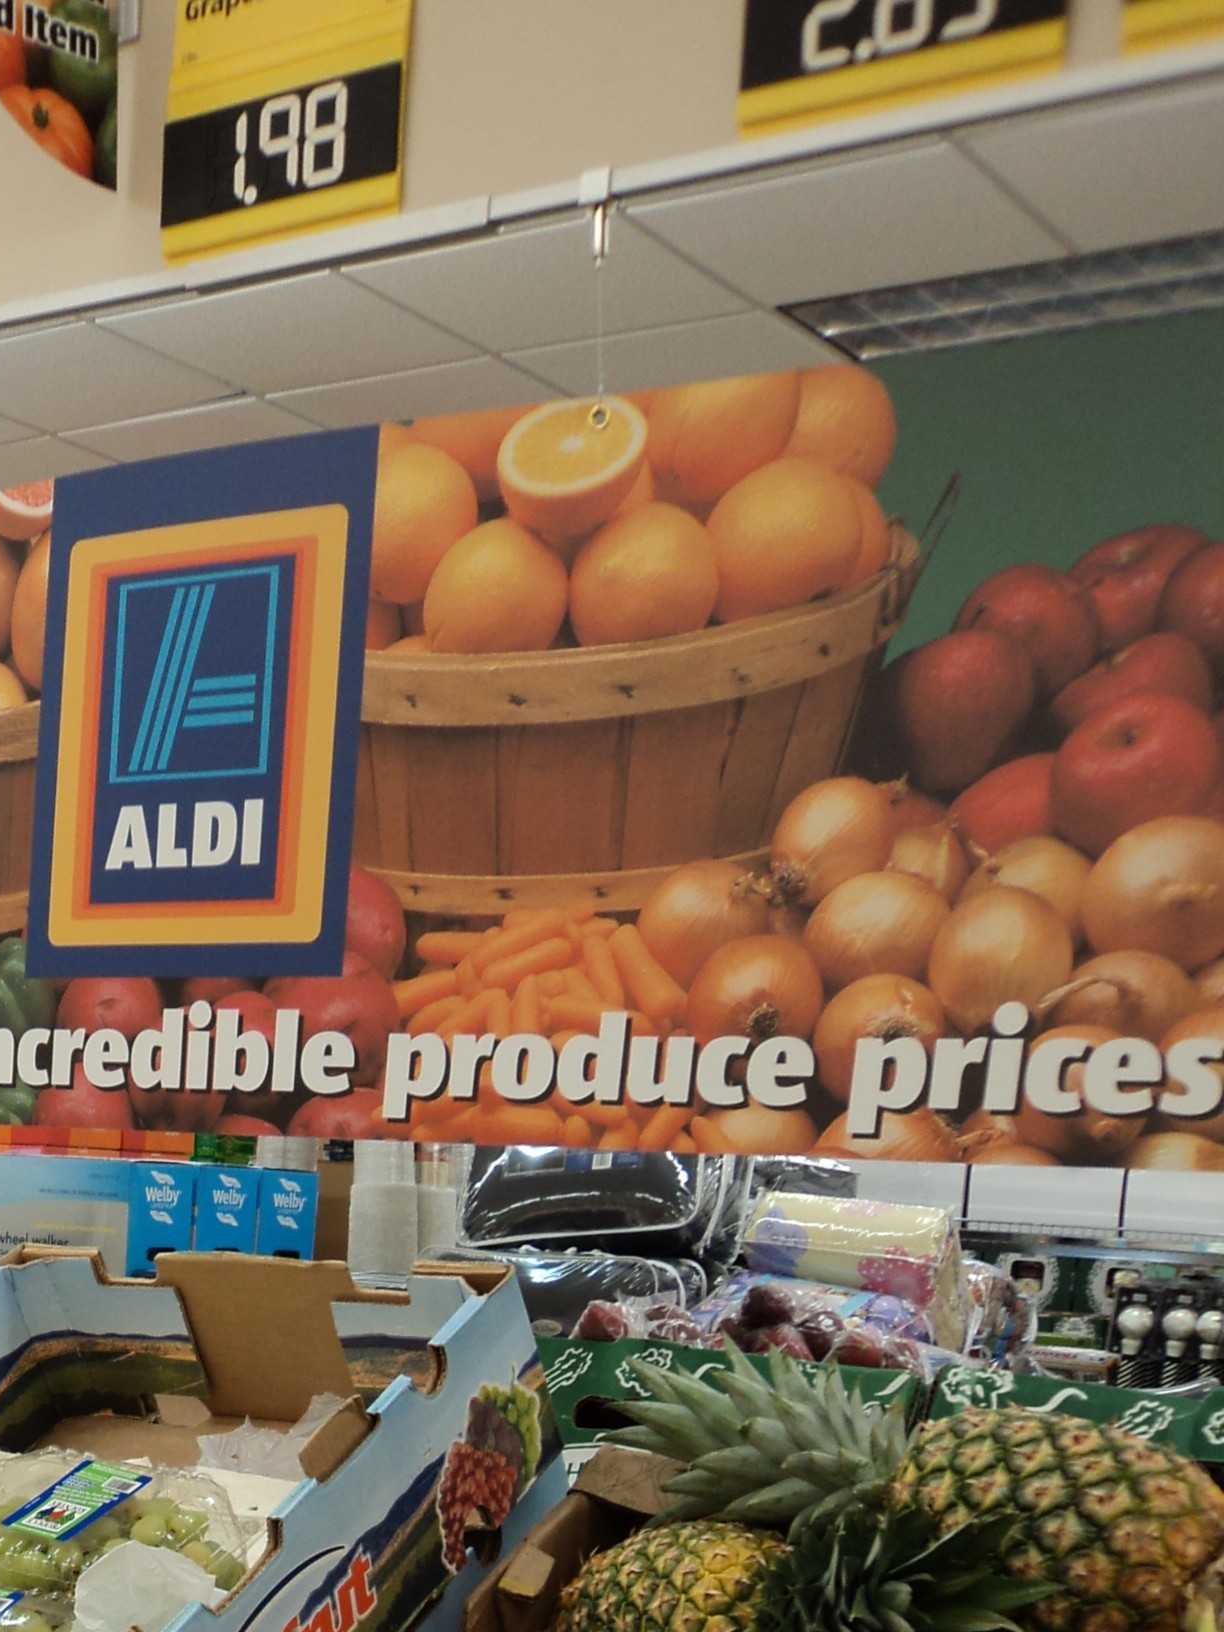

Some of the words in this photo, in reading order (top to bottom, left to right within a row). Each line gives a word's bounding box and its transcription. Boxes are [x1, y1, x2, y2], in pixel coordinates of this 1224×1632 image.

[185, 0, 256, 21] Grap
[23, 3, 100, 63] Item
[234, 80, 348, 205] 1.98
[105, 799, 264, 870] ALDI
[381, 1011, 816, 1122] produce
[846, 1000, 1224, 1138] prices
[145, 1186, 181, 1206] Welby
[213, 1189, 246, 1209] Welby
[273, 1192, 307, 1212] Welby
